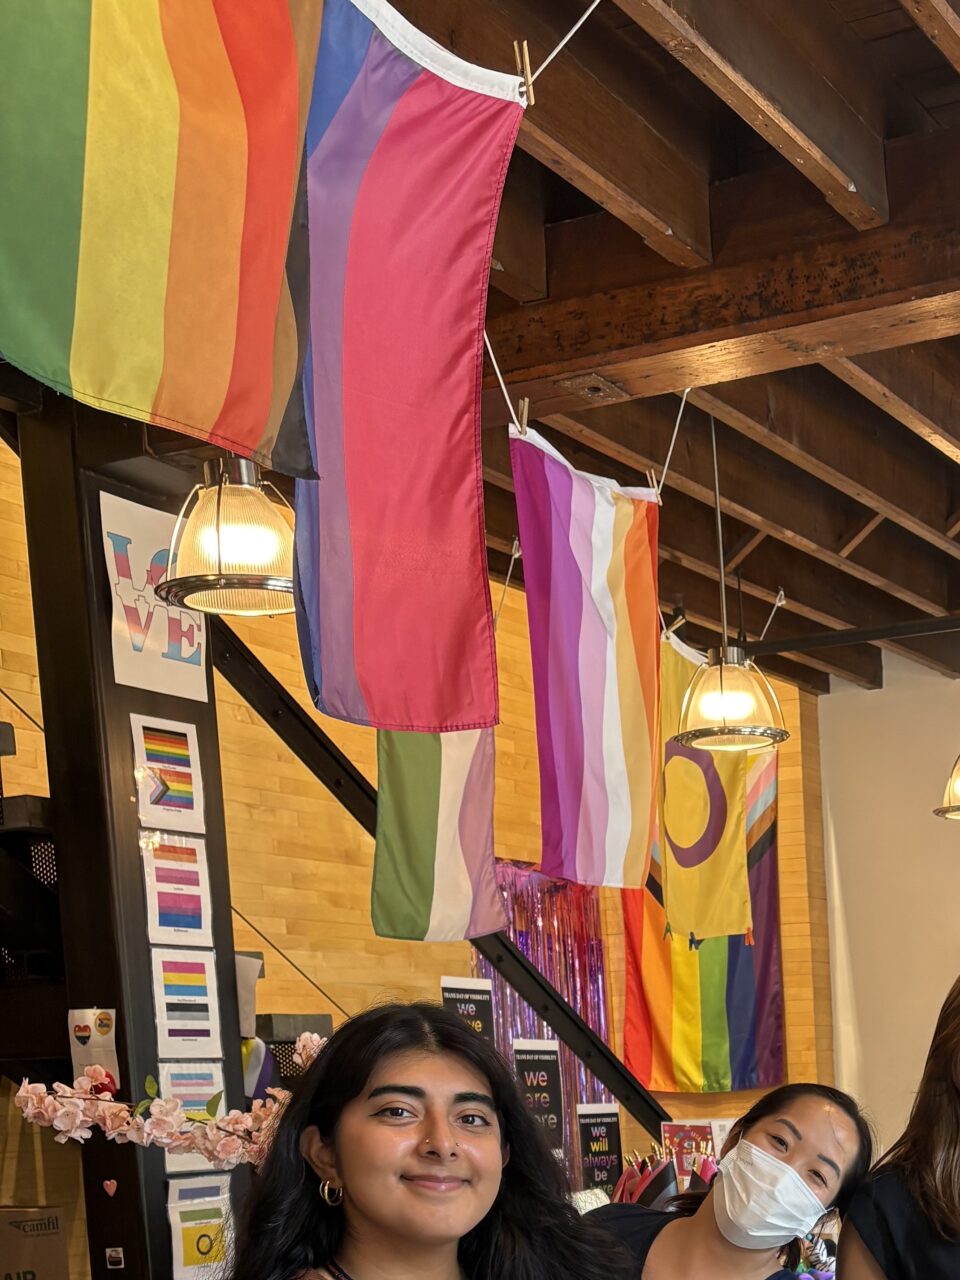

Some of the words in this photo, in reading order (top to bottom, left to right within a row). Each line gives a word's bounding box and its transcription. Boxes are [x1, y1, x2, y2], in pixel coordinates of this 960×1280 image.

[457, 1002, 476, 1015] we
[525, 1071, 548, 1087] we
[525, 1093, 550, 1108] are
[591, 1125, 606, 1137] we
[590, 1138, 608, 1152] will
[583, 1153, 617, 1169] always
[594, 1169, 607, 1181] be
[22, 1215, 59, 1233] camfil
